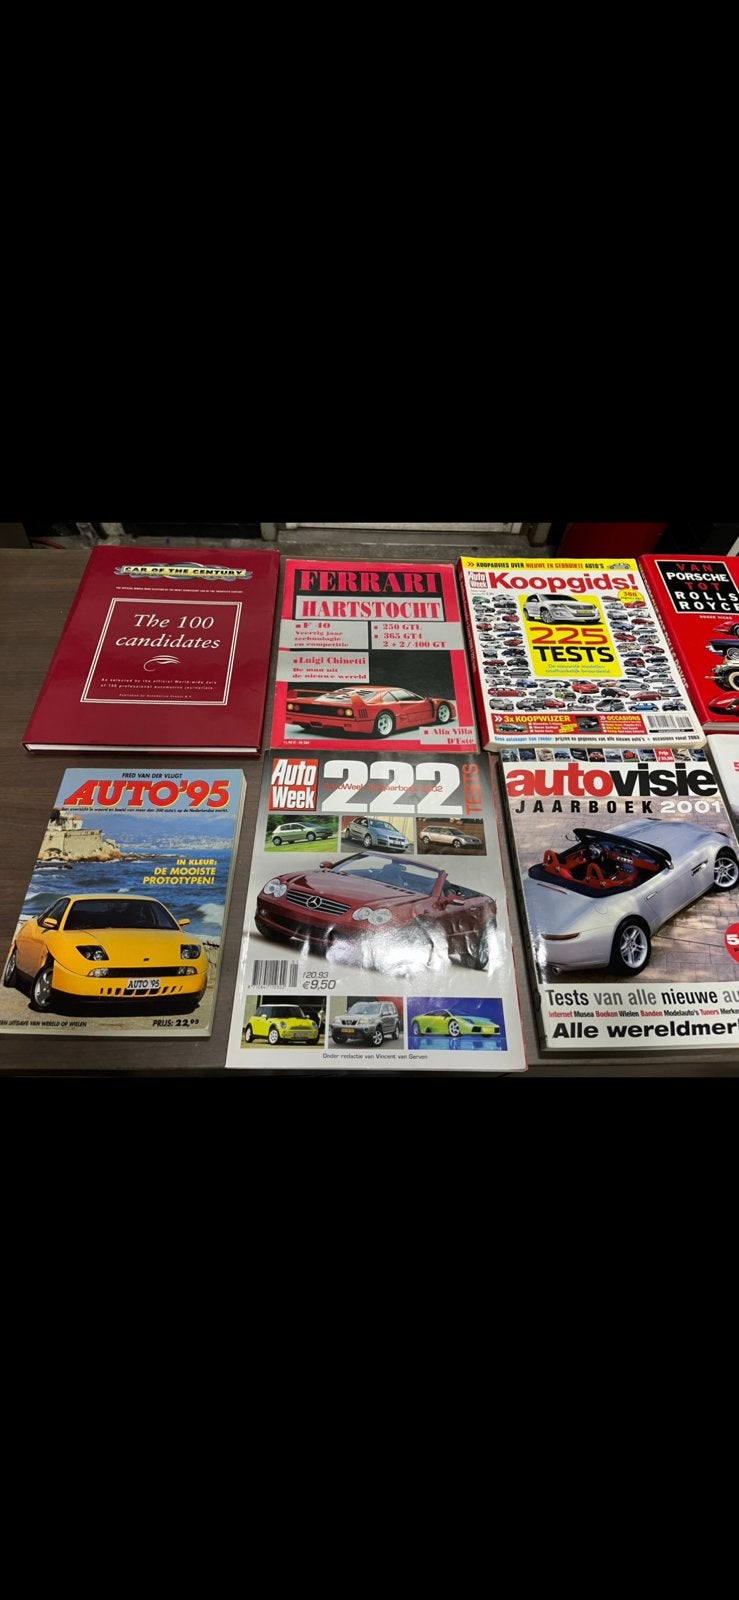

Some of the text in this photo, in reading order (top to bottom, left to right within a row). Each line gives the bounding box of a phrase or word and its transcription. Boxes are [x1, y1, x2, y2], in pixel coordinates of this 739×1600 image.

[675, 563, 713, 571] VAN
[299, 570, 438, 593] FERRARI
[469, 572, 486, 581] Auto
[488, 572, 638, 593] Koopgids!
[666, 572, 729, 582] PORSCHE
[470, 580, 487, 588] Week
[684, 582, 720, 591] TOT
[674, 591, 739, 602] ROLLS
[302, 600, 440, 619] HARTSTOCHT
[134, 614, 214, 629] The 100
[116, 634, 220, 649] candidates
[383, 632, 400, 640] 365
[529, 626, 608, 645] 225
[383, 640, 389, 648] 2
[533, 646, 614, 663] TESTS
[299, 657, 366, 665] Luigi Chinetti
[271, 759, 317, 785] Auto
[506, 763, 718, 798] autovisie
[321, 759, 463, 815] 222
[324, 783, 365, 791] AutoWeek
[421, 785, 444, 793] 2002
[463, 763, 483, 815] TESTS
[64, 780, 231, 808] AUTO'95
[272, 786, 315, 809] Week
[515, 800, 721, 814] JAARBOEK 2001
[154, 867, 216, 876] DE MOOISTE
[143, 876, 215, 885] PROTOTYPEN!
[127, 979, 160, 988] AUTO '95
[302, 980, 336, 990] €9,50
[545, 989, 589, 1006] Tests
[593, 991, 623, 1005] van
[628, 989, 657, 1005] alle
[661, 988, 718, 1005] nieuwe
[548, 1010, 573, 1018] Internet
[595, 1010, 618, 1018] Boeken
[699, 1008, 720, 1016] Tuners
[152, 1019, 200, 1027] PRIJS: 22,95
[552, 1019, 739, 1039] Alle wereldmer
